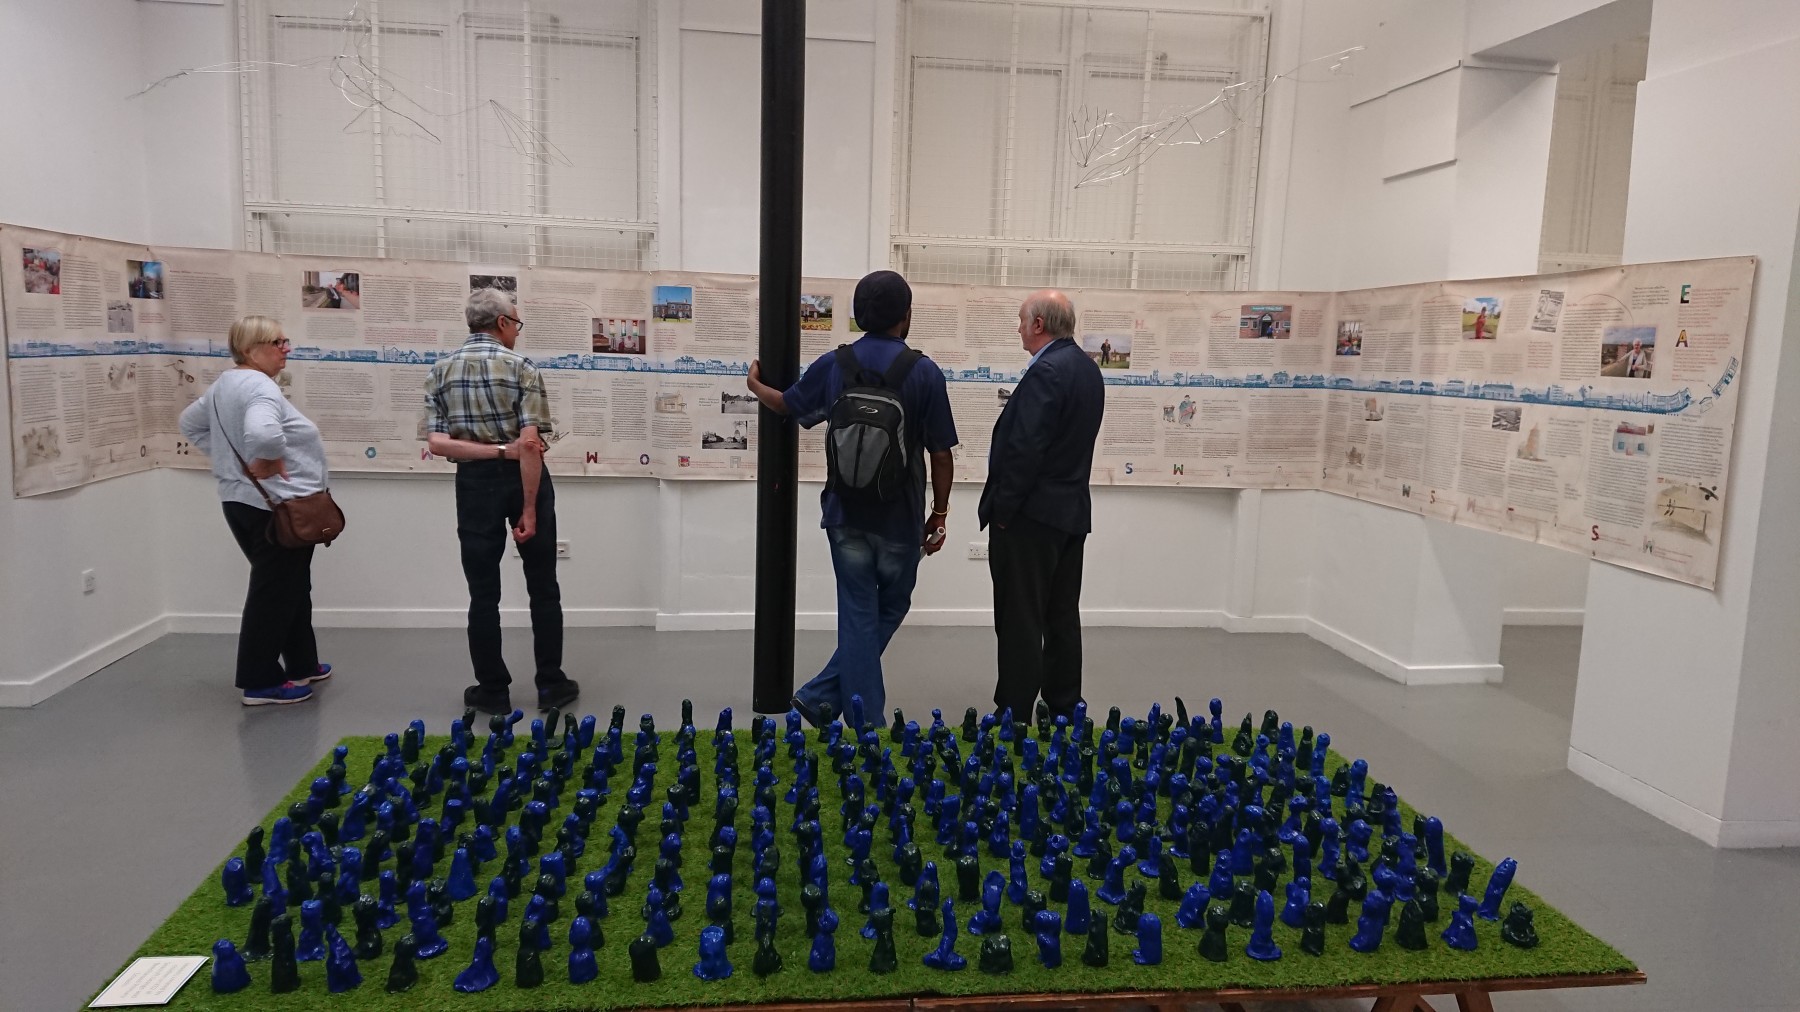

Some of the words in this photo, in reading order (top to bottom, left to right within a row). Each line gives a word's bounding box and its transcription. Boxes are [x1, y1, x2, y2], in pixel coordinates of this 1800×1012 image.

[1680, 285, 1691, 304] E
[1676, 329, 1688, 347] A
[586, 452, 598, 463] W
[640, 454, 650, 465] O
[1125, 463, 1133, 474] S
[1174, 464, 1184, 475] W
[1591, 525, 1599, 541] S
